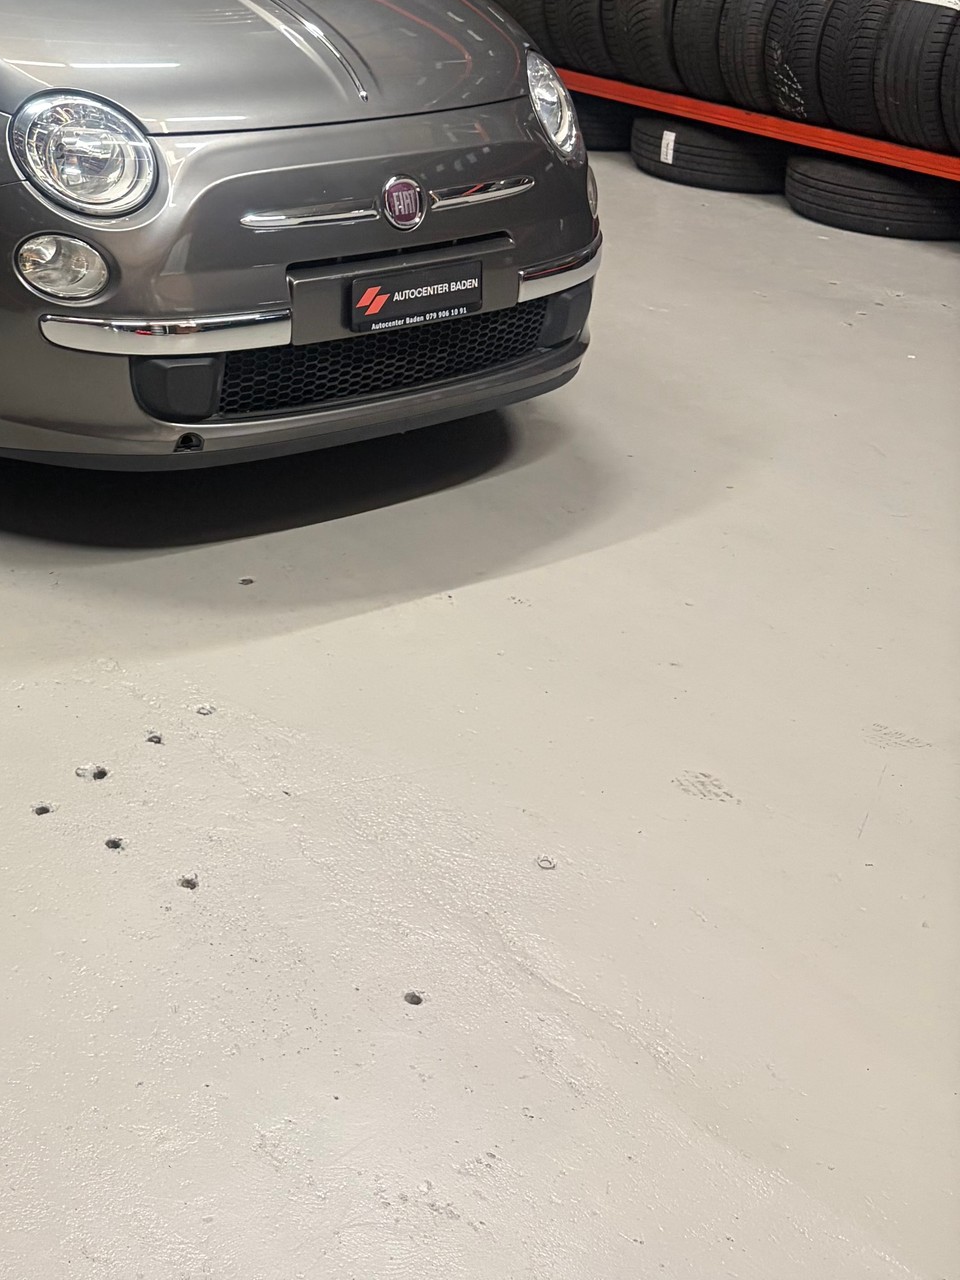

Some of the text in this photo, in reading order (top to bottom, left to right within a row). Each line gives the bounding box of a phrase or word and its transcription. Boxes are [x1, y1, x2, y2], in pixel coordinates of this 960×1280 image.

[392, 189, 416, 216] FIAT
[393, 278, 478, 302] AUTOCENTER BADEN
[371, 318, 404, 330] Autocenter
[406, 315, 424, 324] Baden
[425, 312, 437, 321] 079
